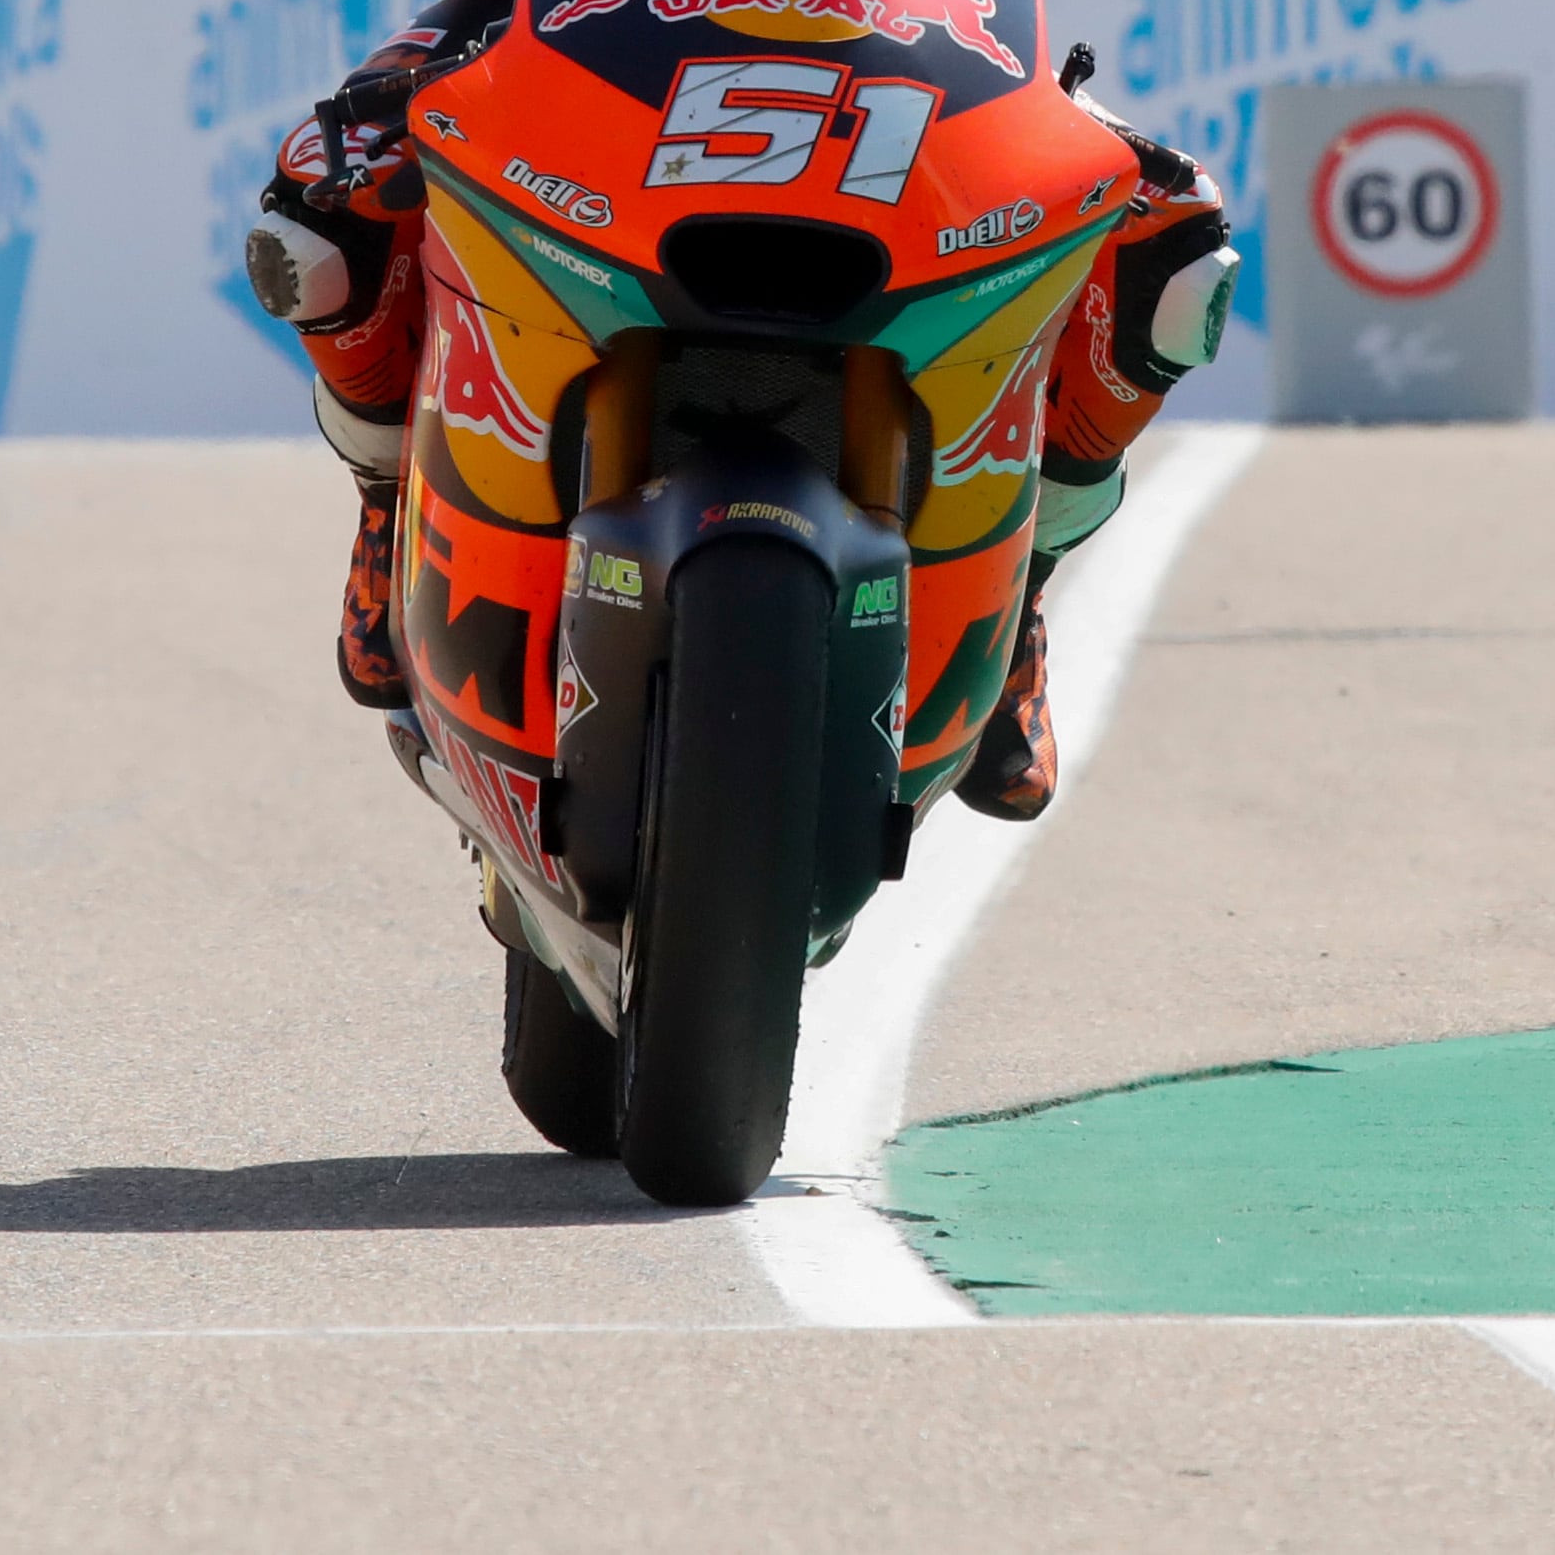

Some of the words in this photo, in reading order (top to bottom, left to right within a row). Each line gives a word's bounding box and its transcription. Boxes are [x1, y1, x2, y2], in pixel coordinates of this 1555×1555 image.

[643, 61, 936, 205] 51
[1344, 170, 1465, 243] 60
[533, 235, 614, 291] MOTOREX
[588, 552, 642, 596] NG
[616, 596, 643, 610] Disc
